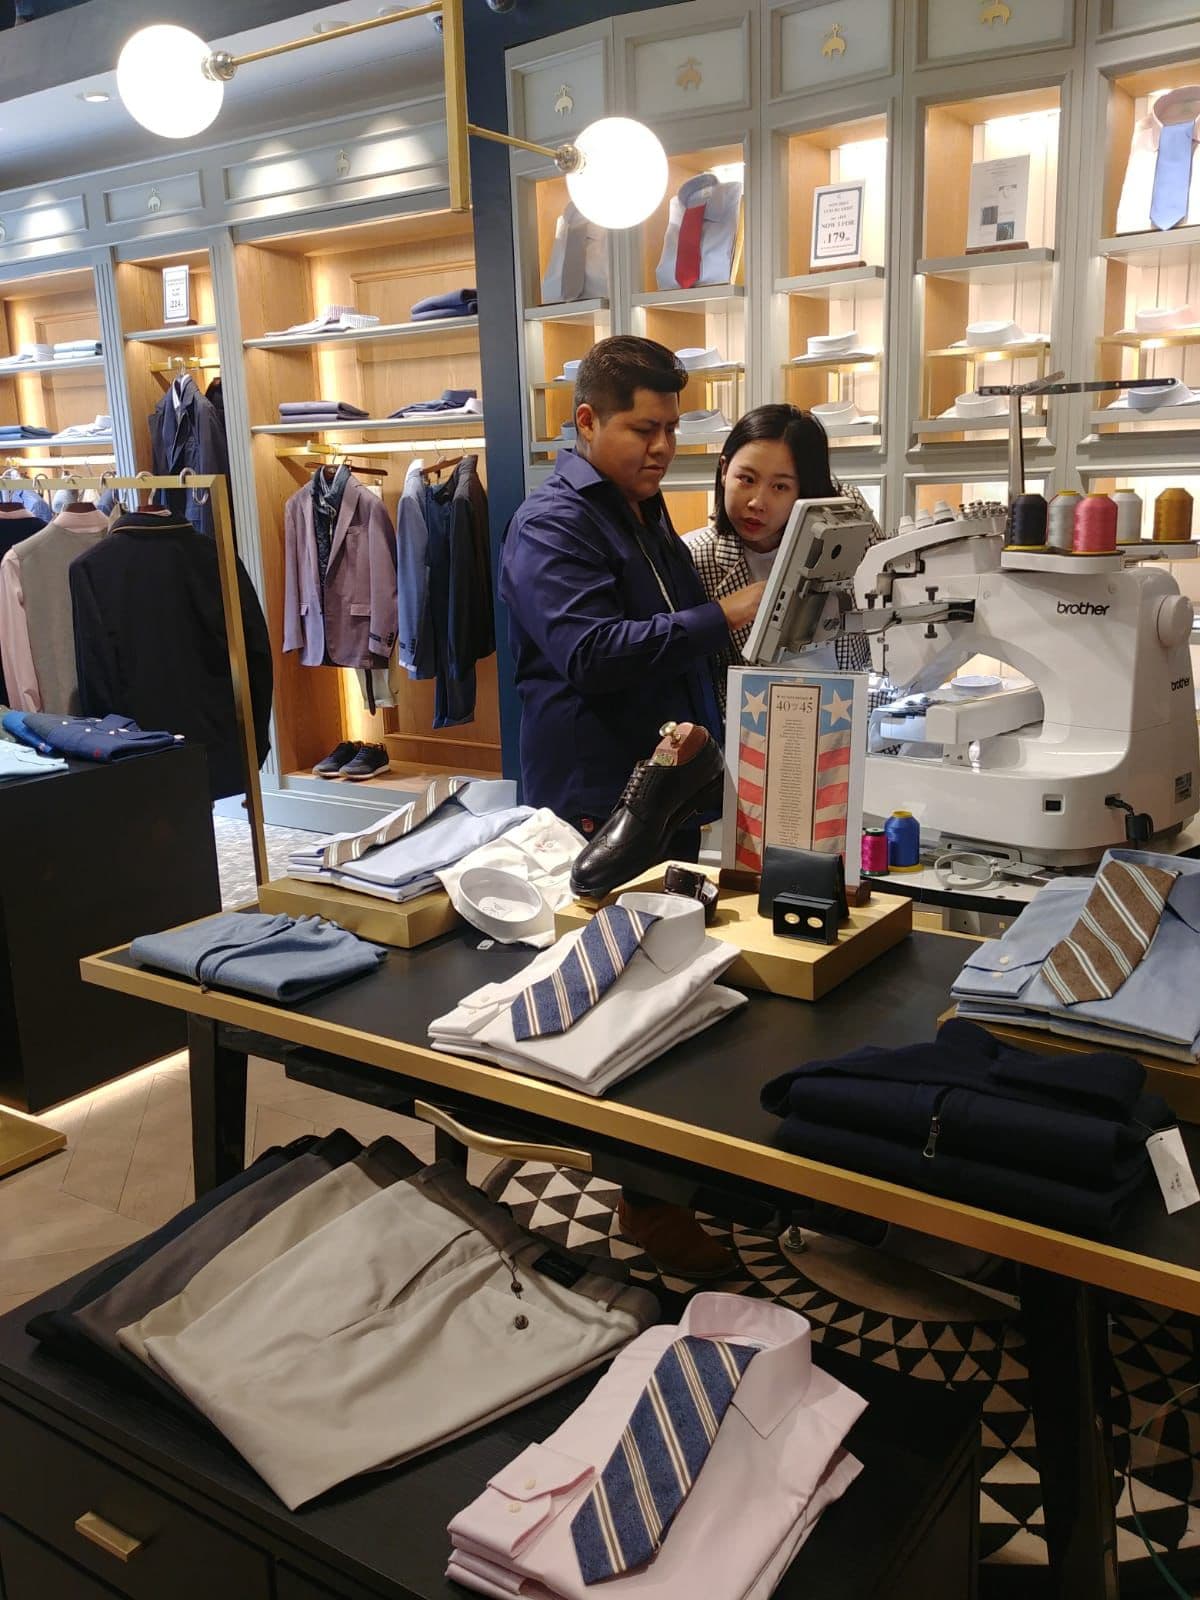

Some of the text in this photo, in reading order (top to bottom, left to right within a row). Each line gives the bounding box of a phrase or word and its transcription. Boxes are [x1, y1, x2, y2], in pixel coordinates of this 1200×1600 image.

[1056, 601, 1110, 616] brother
[1170, 677, 1190, 691] brother
[776, 700, 791, 712] 40
[799, 701, 813, 714] 45
